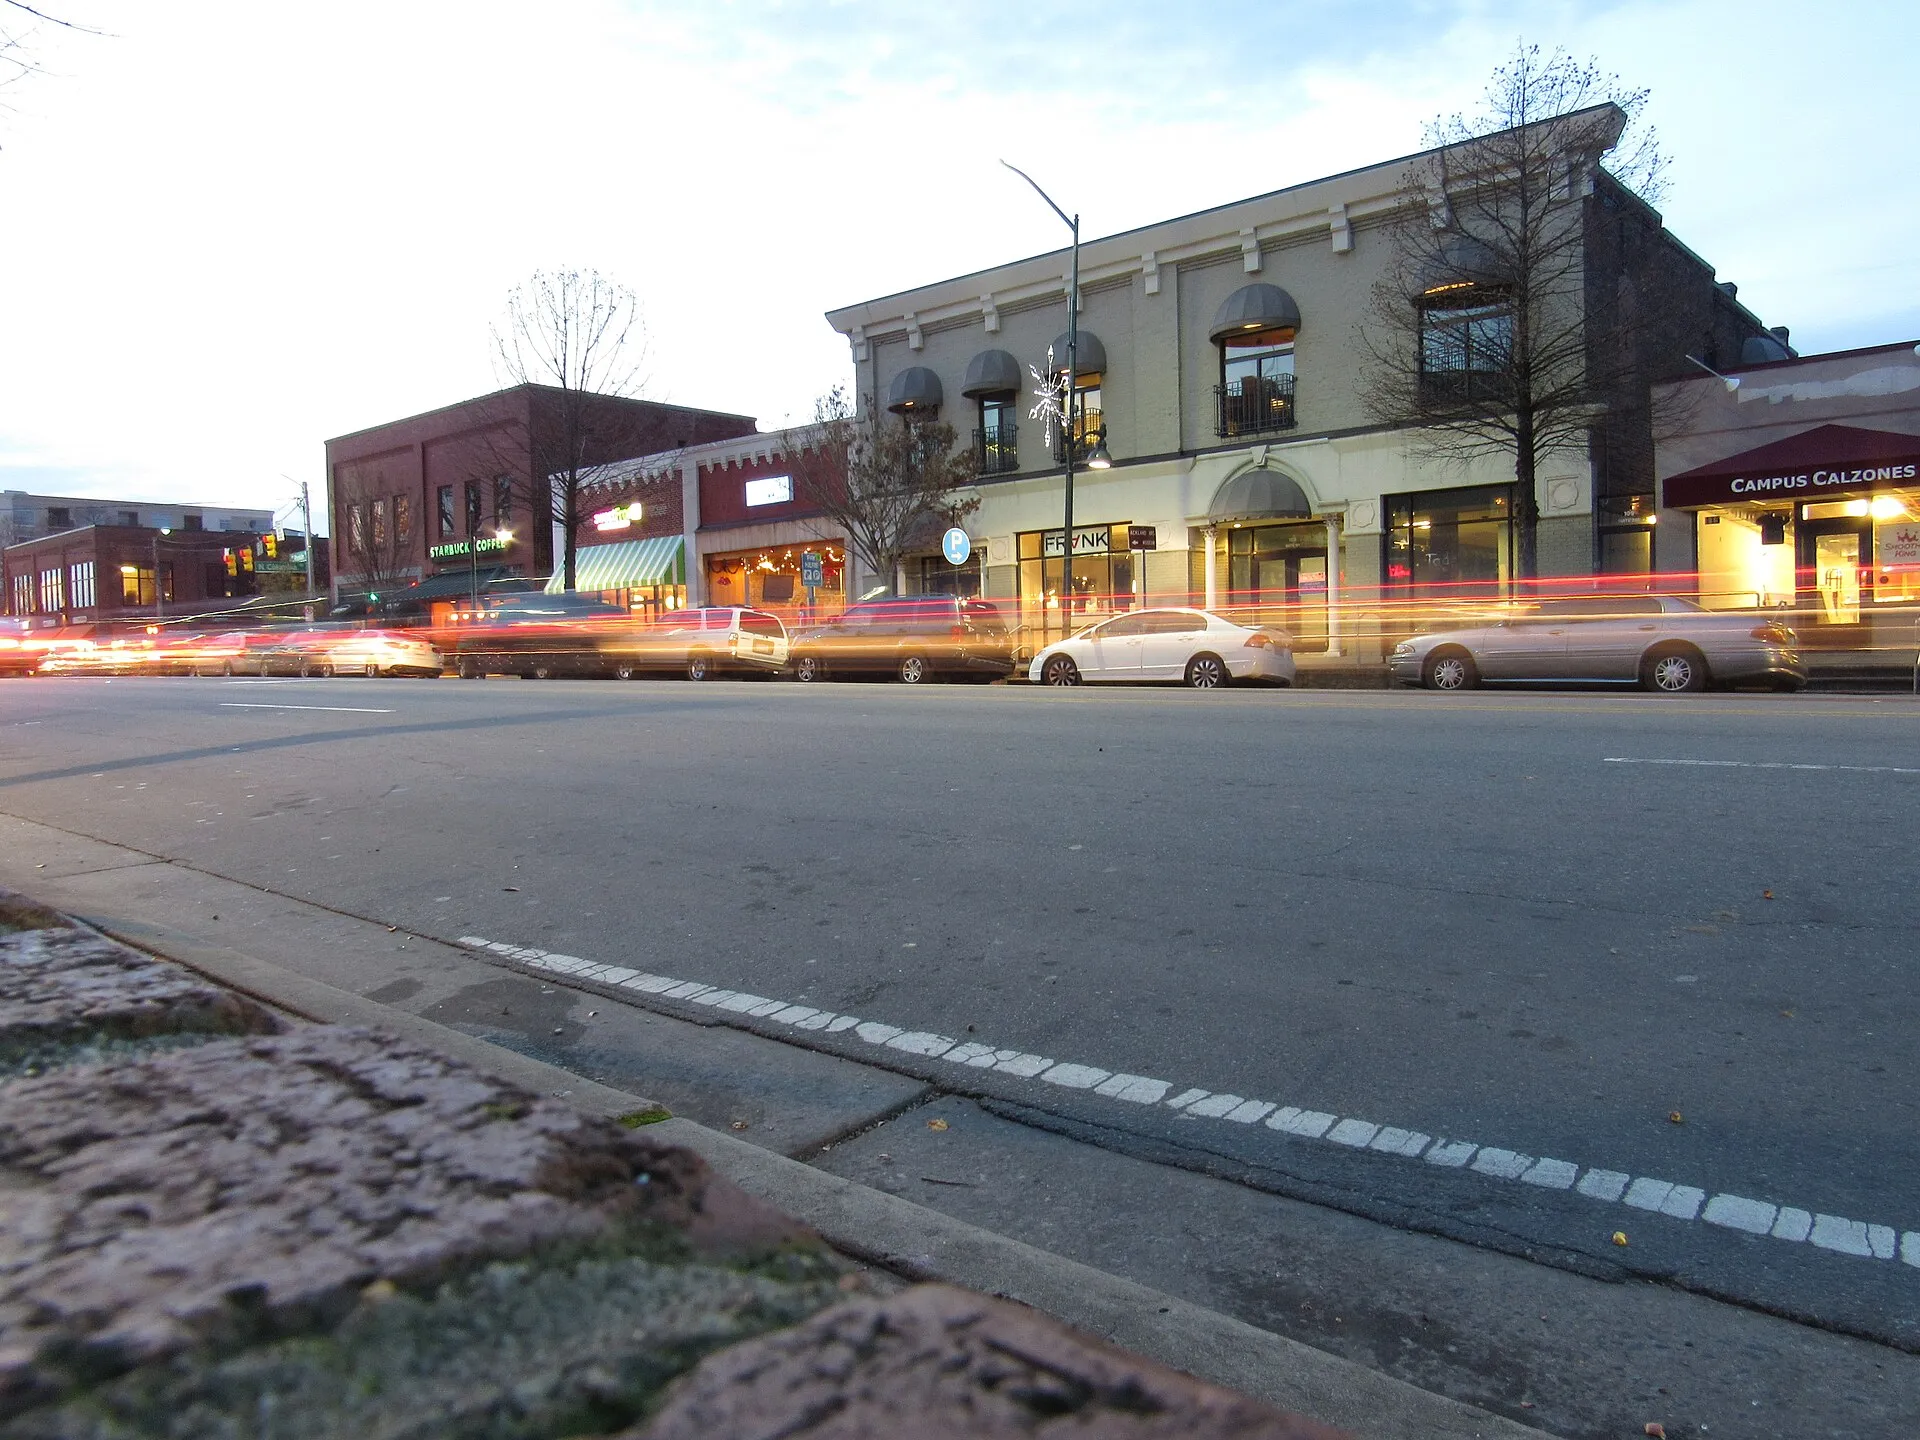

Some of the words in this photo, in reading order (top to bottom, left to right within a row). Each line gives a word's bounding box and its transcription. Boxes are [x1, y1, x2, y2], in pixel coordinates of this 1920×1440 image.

[1731, 475, 1807, 493] CAMPUS
[1812, 465, 1916, 486] CALZONES
[429, 542, 474, 558] STARBUCK
[951, 531, 963, 551] P
